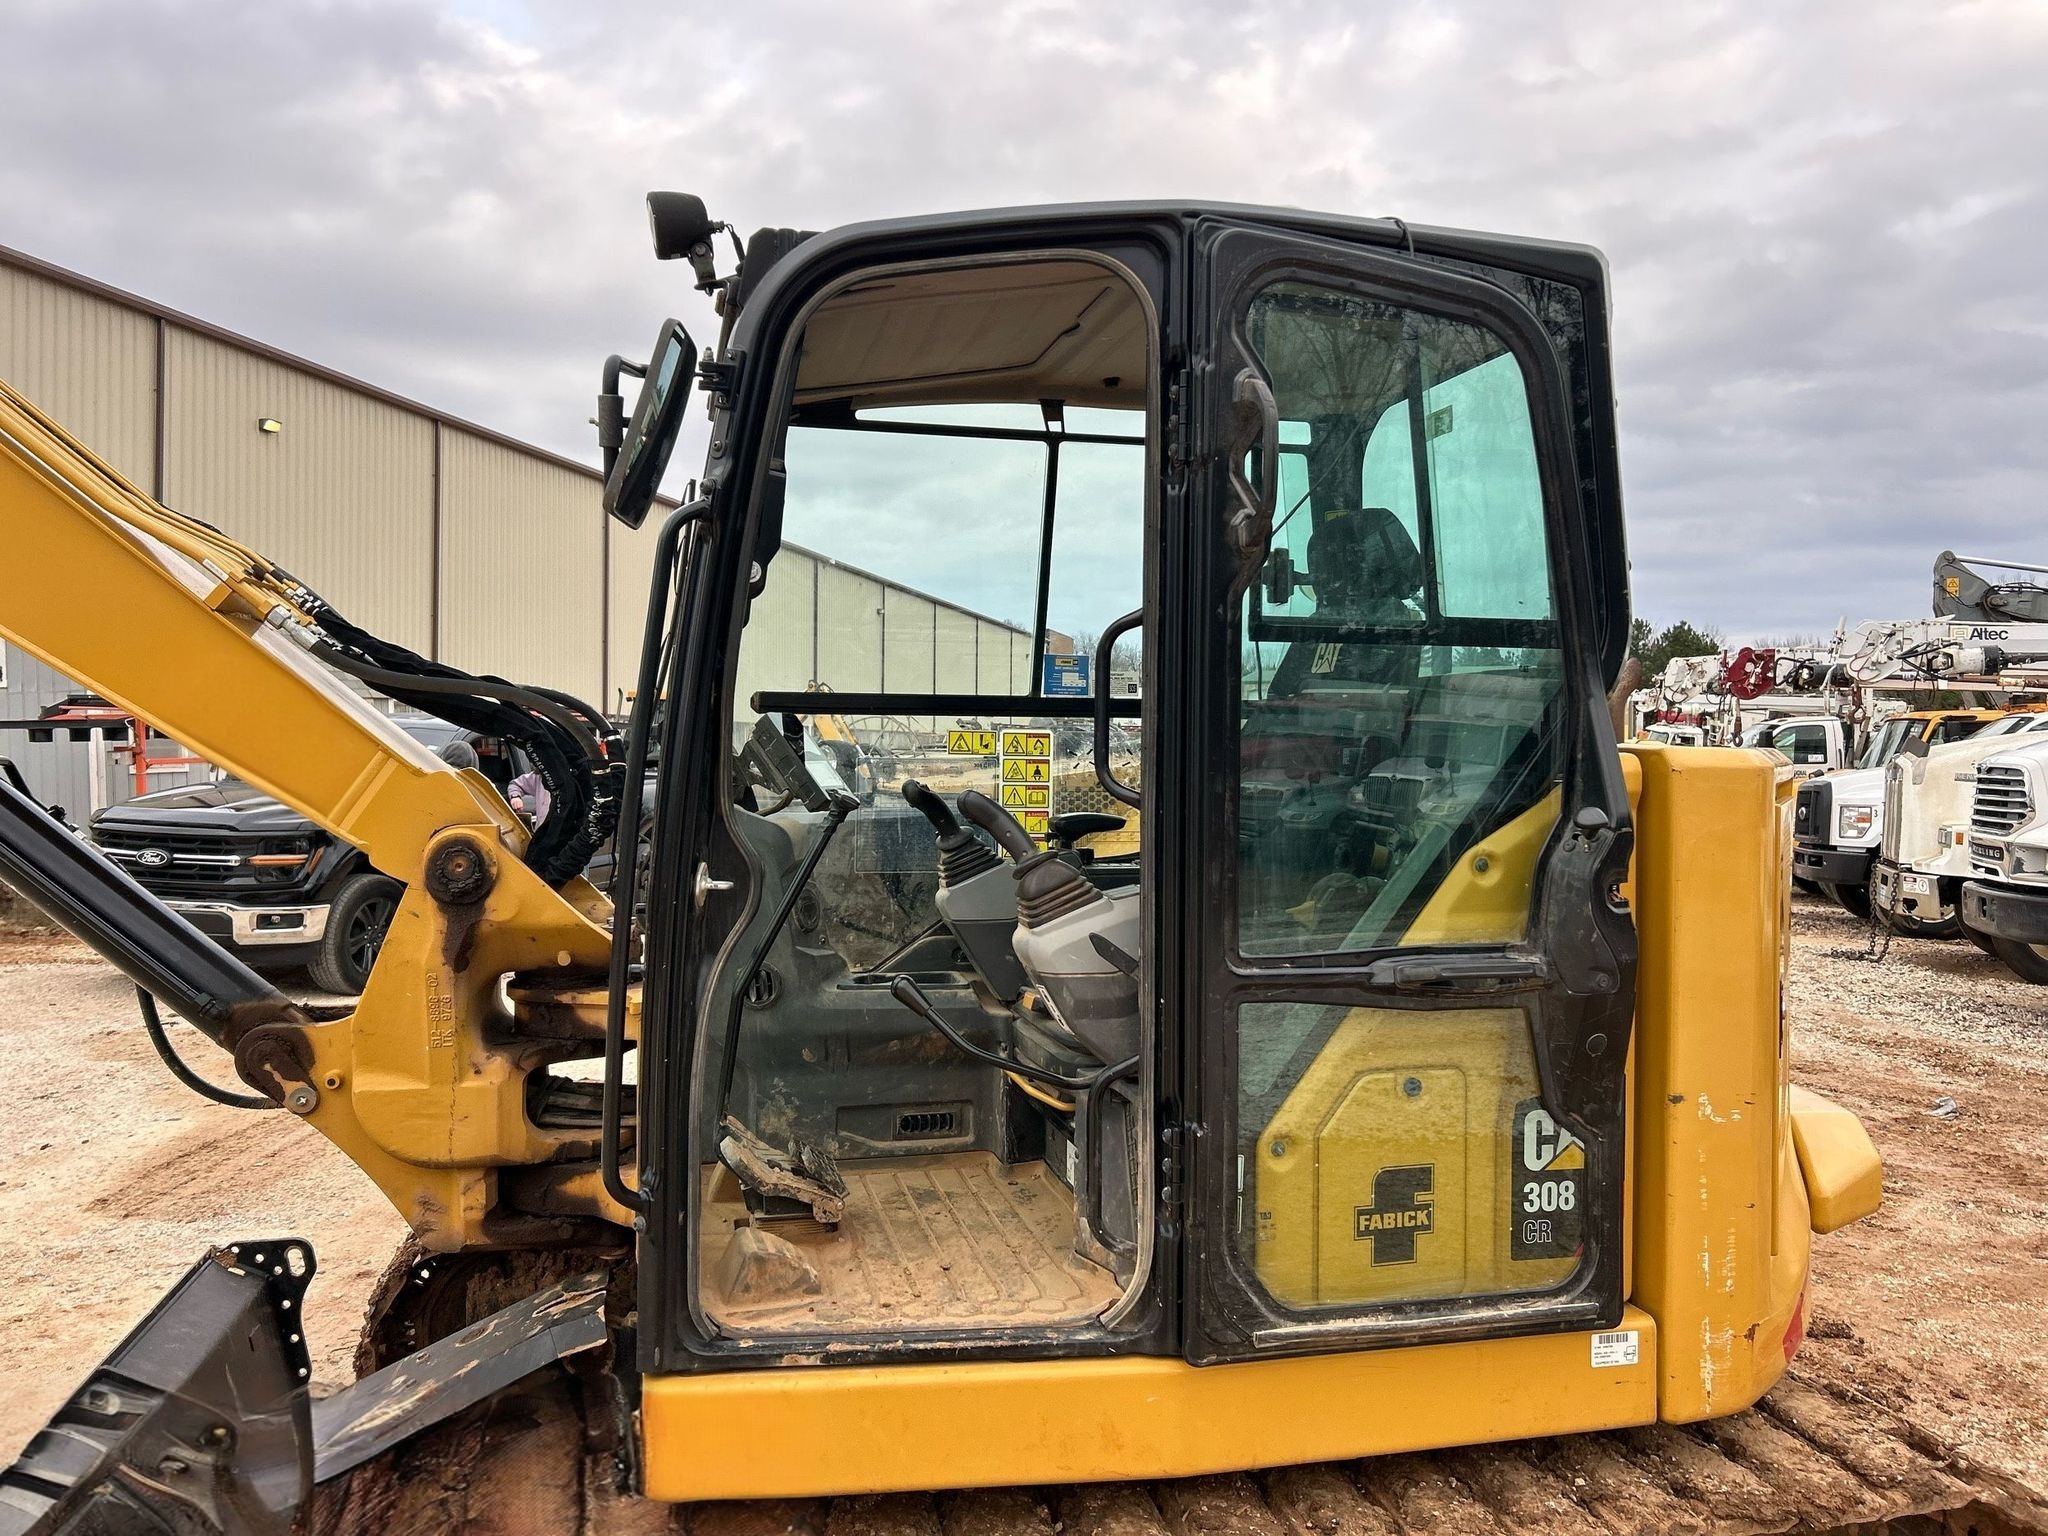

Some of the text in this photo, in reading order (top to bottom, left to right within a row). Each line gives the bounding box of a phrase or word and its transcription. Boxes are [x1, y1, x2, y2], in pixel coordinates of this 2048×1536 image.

[1969, 627, 2009, 640] Altec
[1311, 643, 1343, 673] CAT
[141, 851, 162, 864] Ford
[1523, 1180, 1576, 1213] 308
[1359, 1209, 1430, 1232] FABICK
[1522, 1219, 1553, 1244] CR
